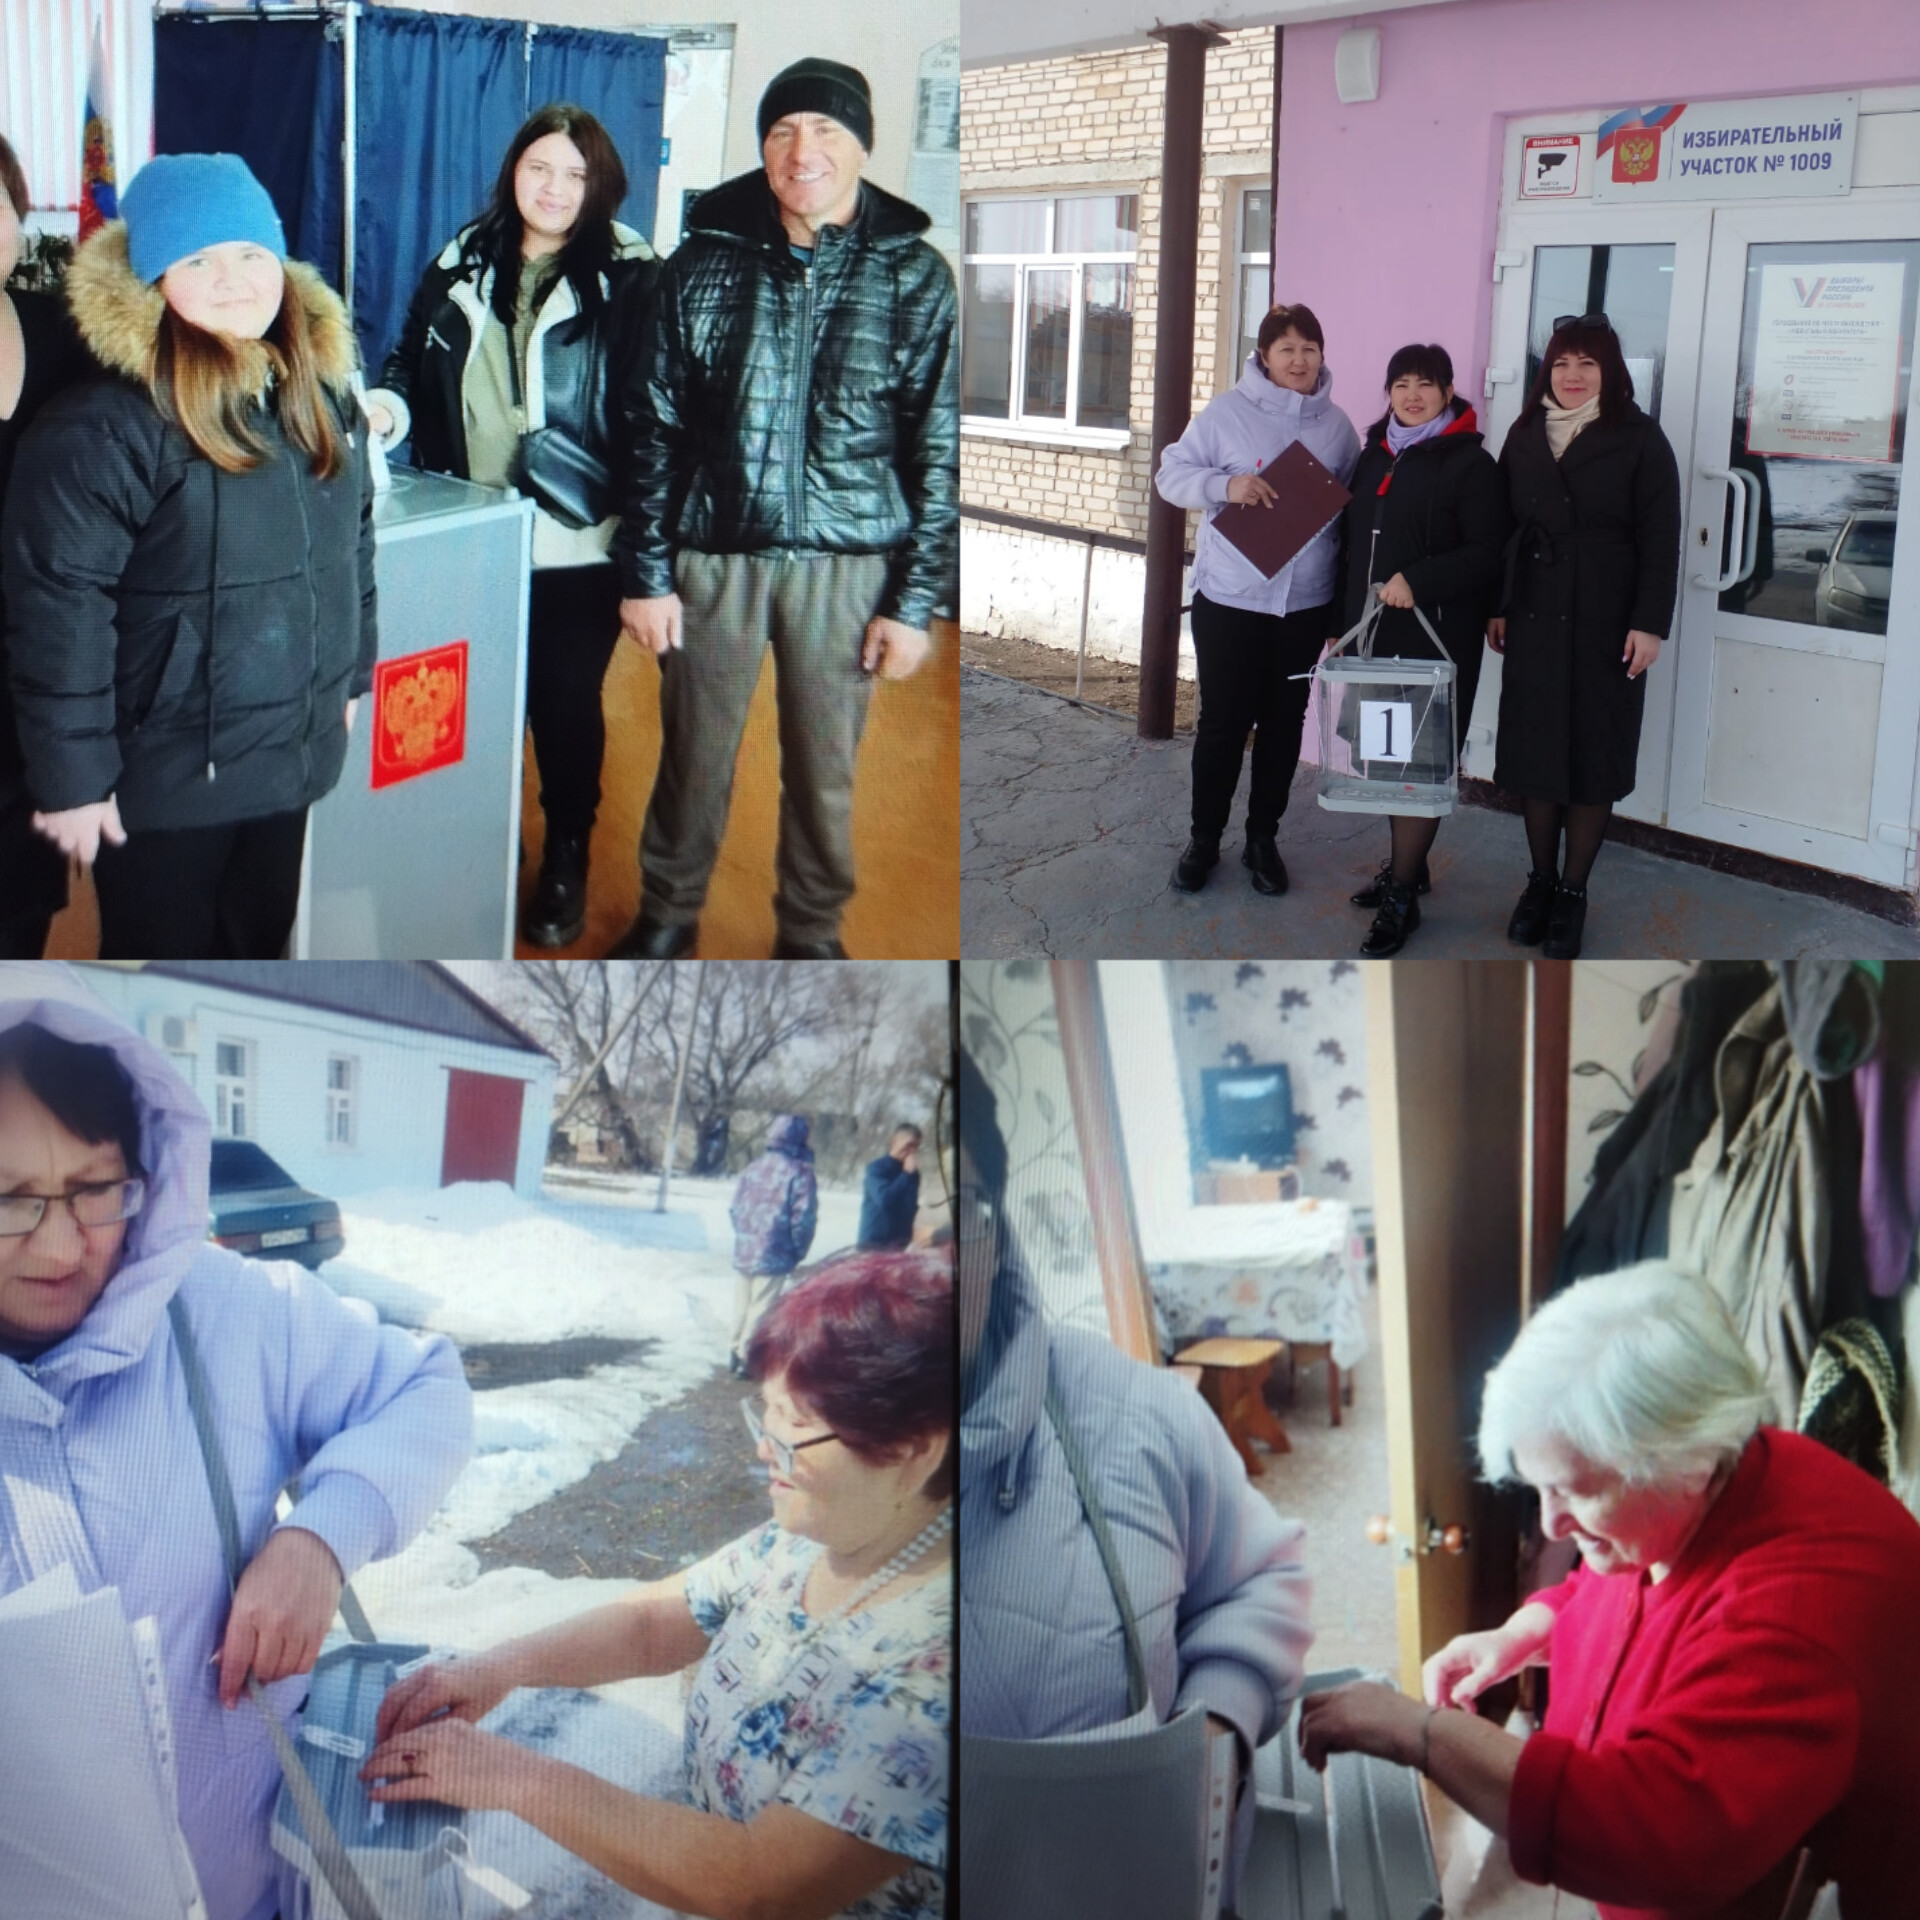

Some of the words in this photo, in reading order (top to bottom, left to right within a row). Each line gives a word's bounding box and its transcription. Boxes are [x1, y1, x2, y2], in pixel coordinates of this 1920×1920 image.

[1683, 117, 1842, 149] ИЗБИРАТЕЛЬНЫЙ
[1680, 155, 1758, 176] УЧАСТОК
[1763, 154, 1785, 172] №
[1790, 152, 1832, 171] 1009
[1379, 708, 1397, 757] 1
